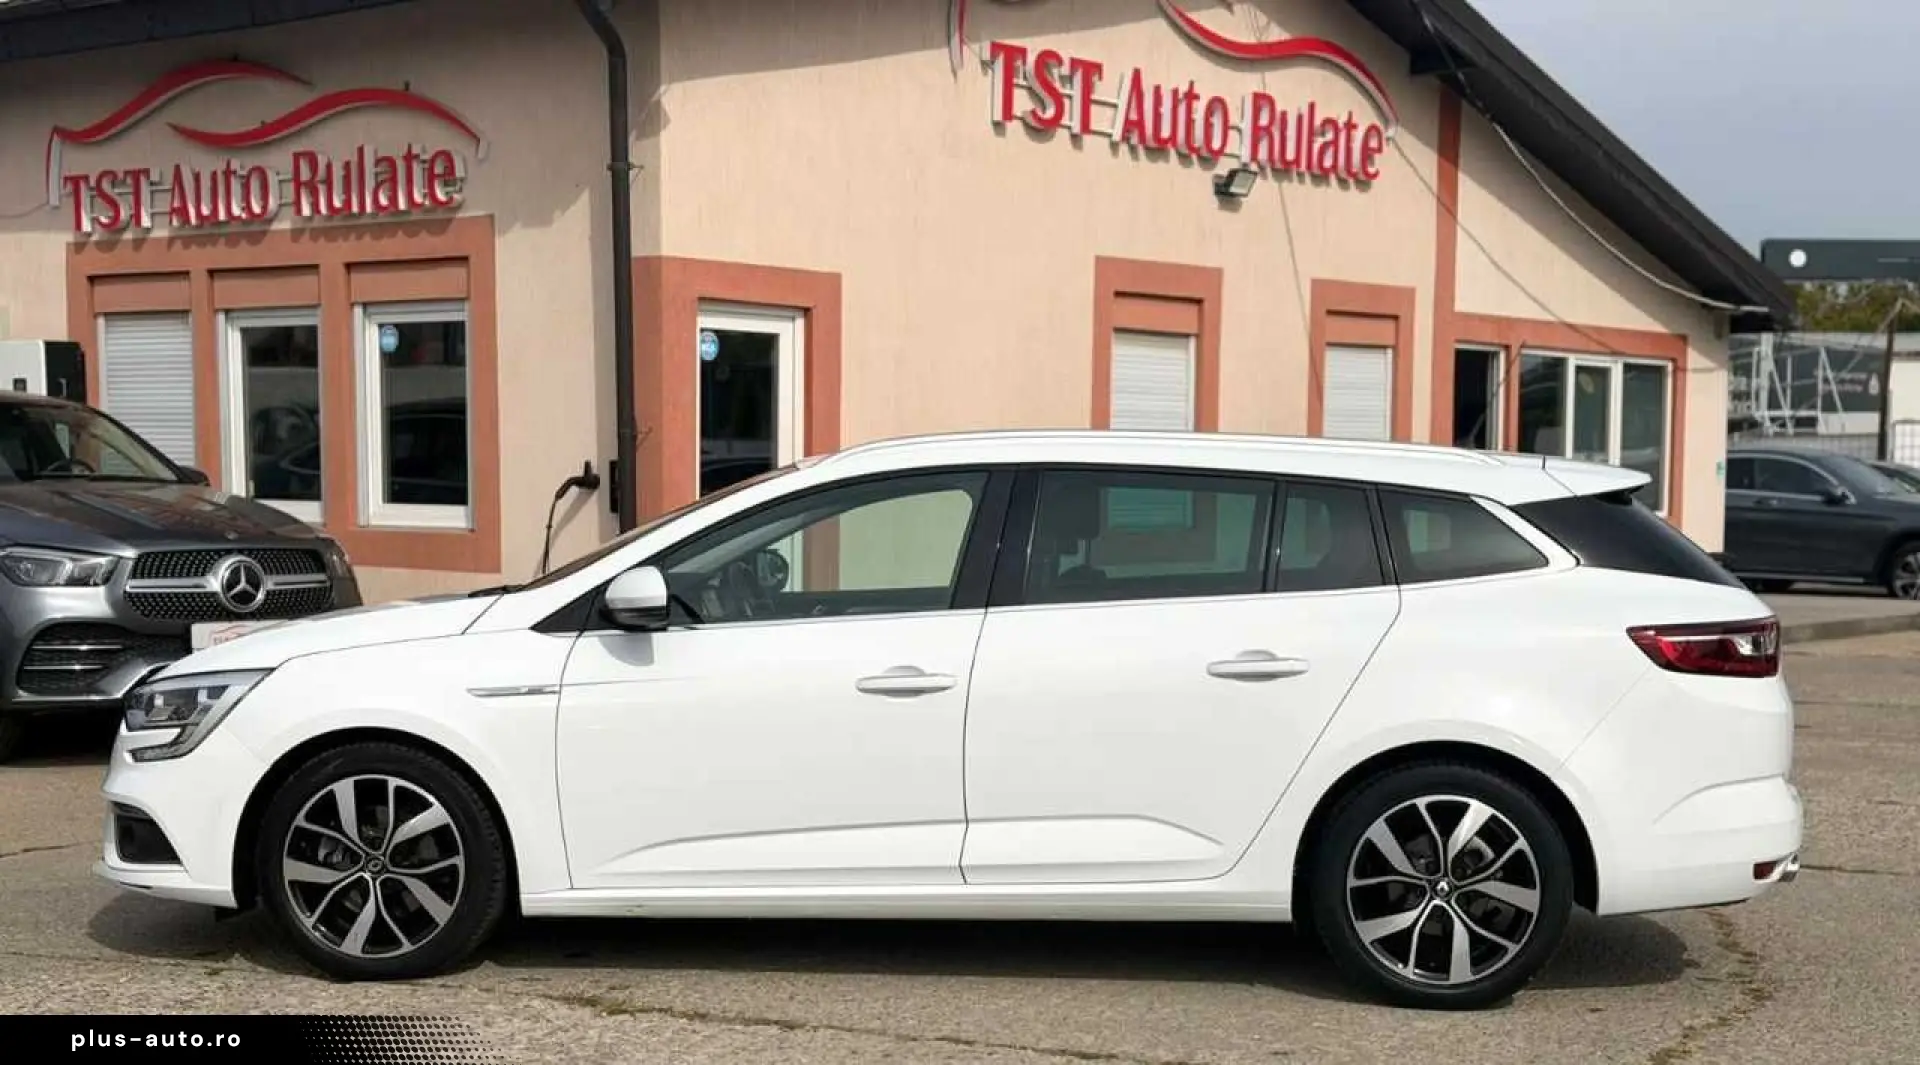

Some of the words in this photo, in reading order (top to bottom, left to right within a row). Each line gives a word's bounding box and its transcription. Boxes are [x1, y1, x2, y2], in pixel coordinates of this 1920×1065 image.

[987, 41, 1105, 134] TST
[1118, 67, 1229, 159] Auto
[1249, 91, 1385, 181] Rulate
[63, 169, 154, 232] TST
[168, 157, 273, 228] Auto
[291, 142, 461, 218] Rulate
